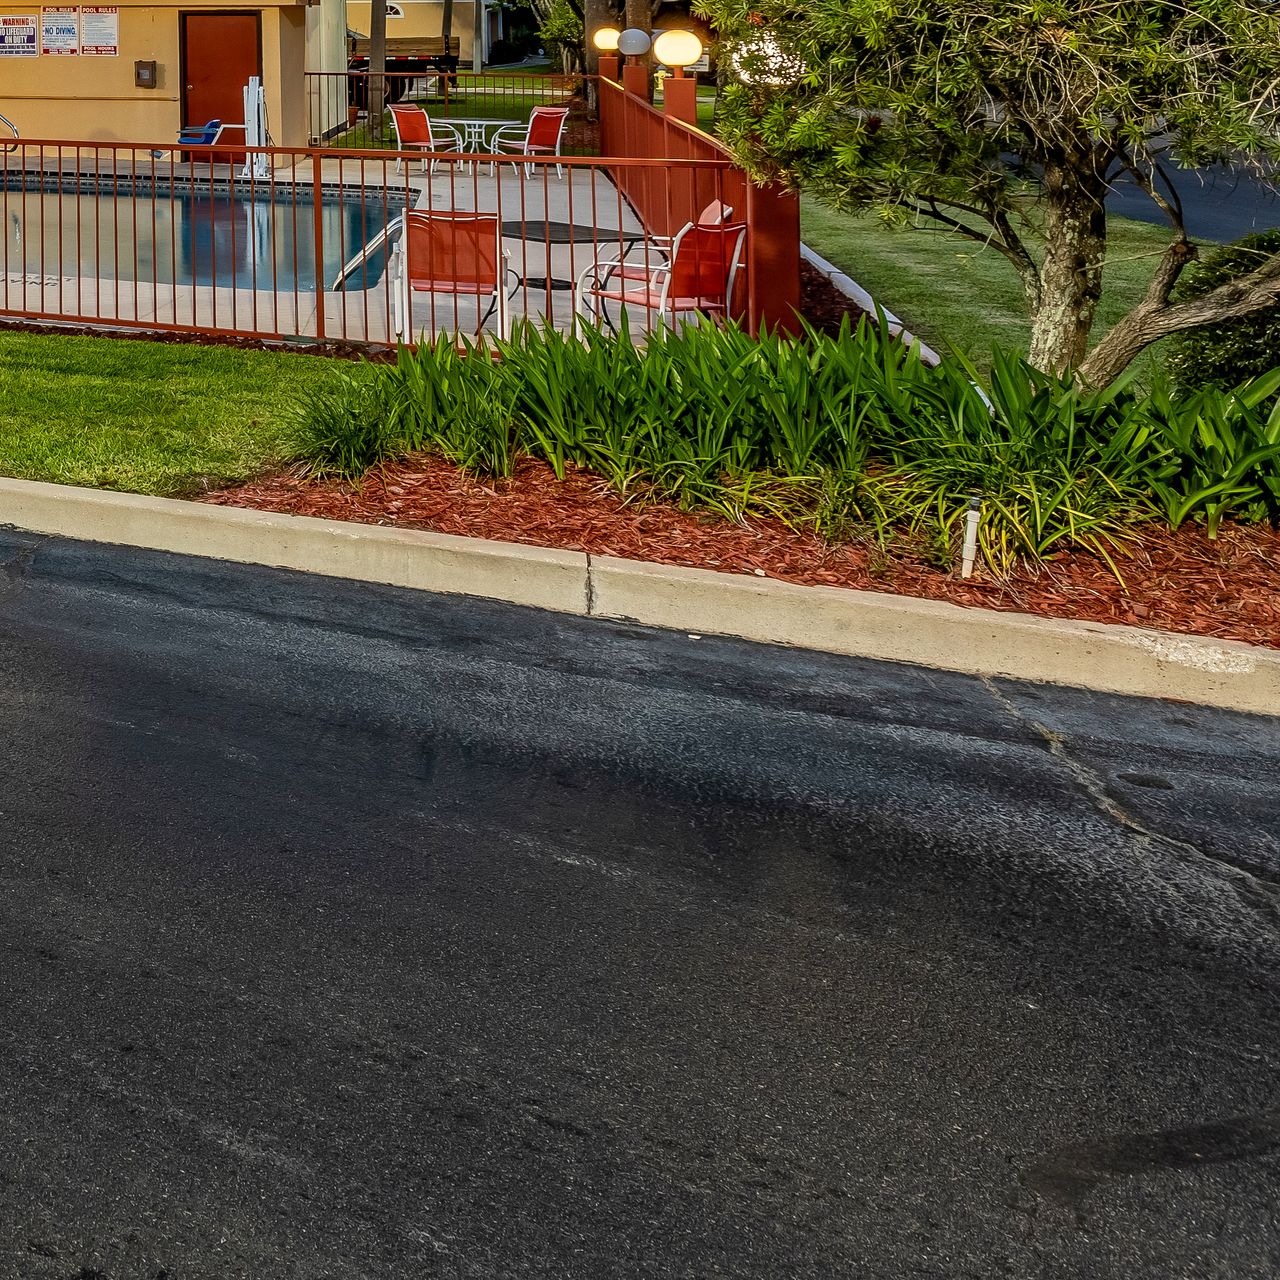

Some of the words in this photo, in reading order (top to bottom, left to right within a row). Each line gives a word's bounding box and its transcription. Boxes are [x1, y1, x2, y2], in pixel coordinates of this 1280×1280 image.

[1, 18, 30, 26] WARNING
[6, 27, 34, 36] LIFEGUARD
[44, 27, 54, 35] NO
[55, 27, 76, 35] DIVING
[4, 35, 13, 44] ON
[13, 35, 28, 44] DUTY
